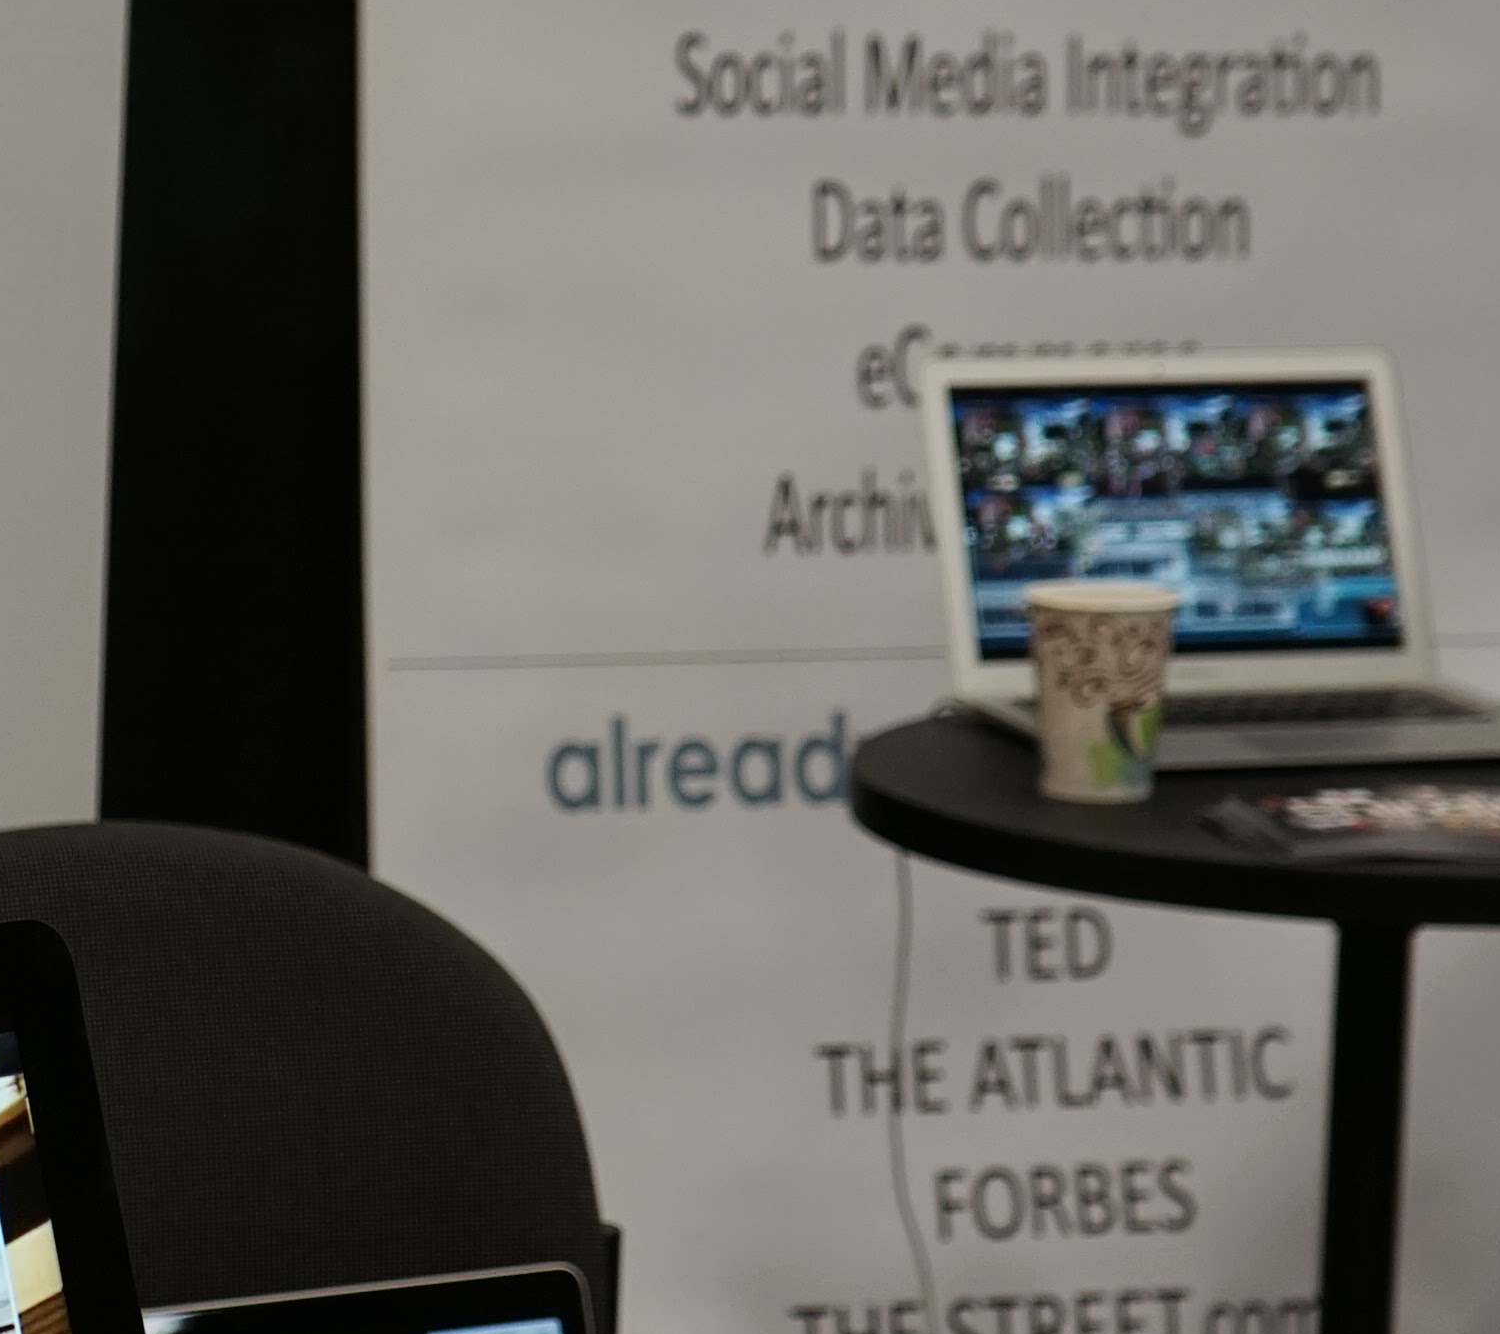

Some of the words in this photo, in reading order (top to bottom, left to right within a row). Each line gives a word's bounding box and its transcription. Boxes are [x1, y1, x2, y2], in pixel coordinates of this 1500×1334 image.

[673, 29, 847, 119] Social
[863, 33, 1049, 119] Media
[1066, 38, 1382, 141] Integration
[811, 177, 946, 265] Data
[960, 175, 1251, 265] Collection
[980, 905, 1113, 984] TED
[815, 1035, 946, 1119] THE
[969, 1025, 1296, 1110] ATLANTIC
[933, 1155, 1200, 1244] FORBES
